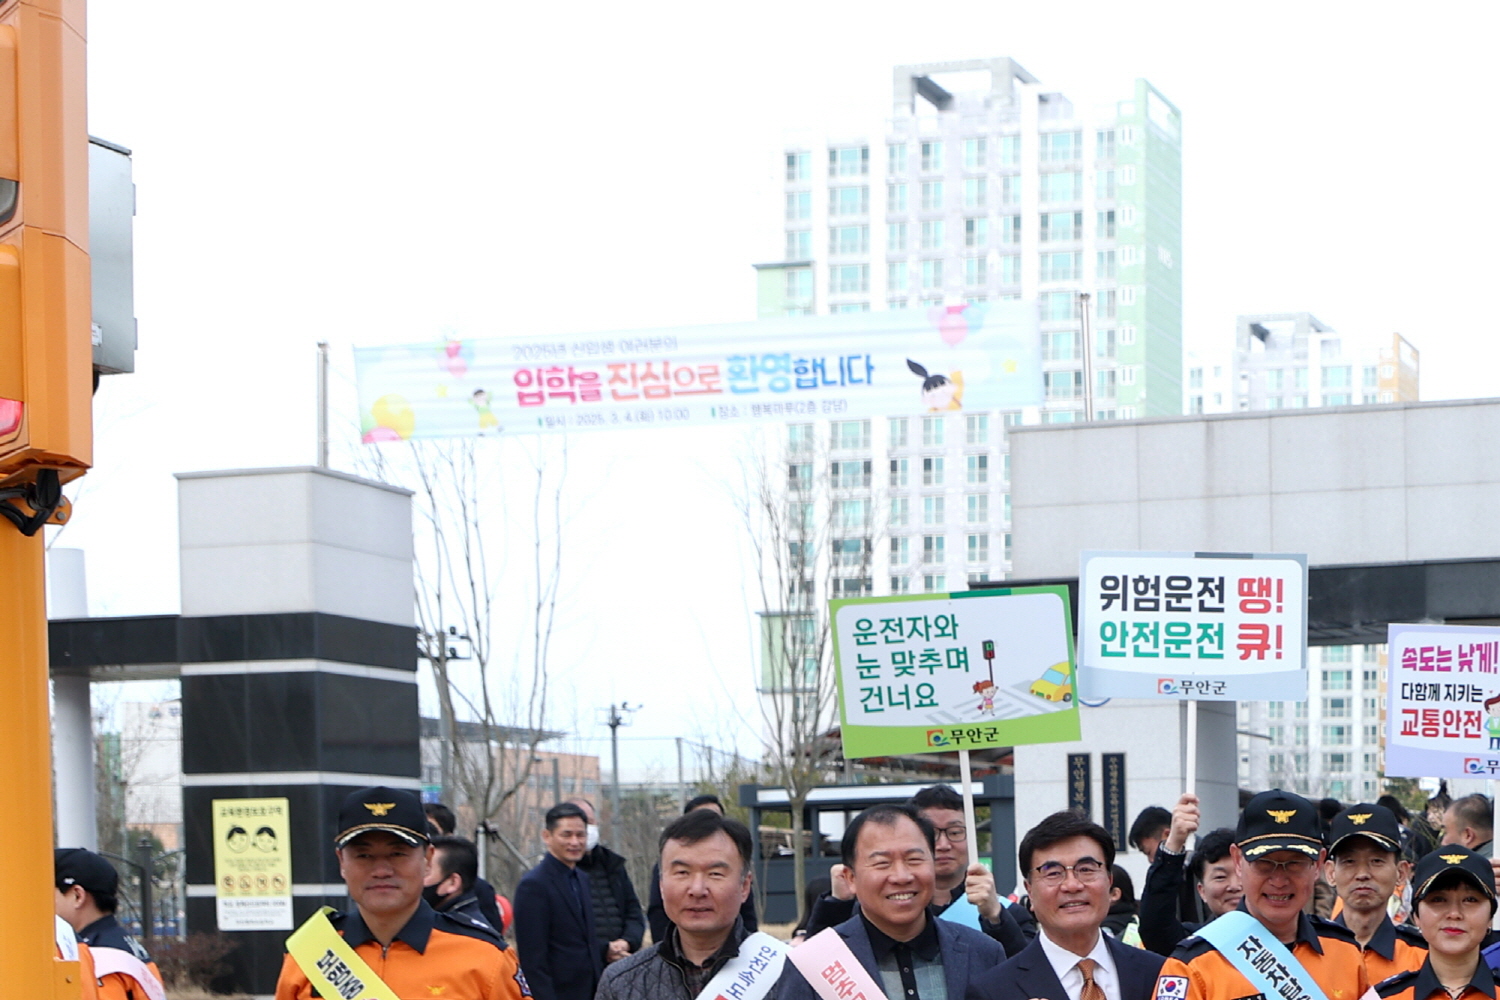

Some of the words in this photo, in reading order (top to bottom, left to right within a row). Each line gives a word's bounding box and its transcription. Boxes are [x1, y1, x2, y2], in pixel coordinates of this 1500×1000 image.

[513, 366, 603, 407] 입학을
[606, 360, 723, 402] 진심으로
[726, 352, 875, 395] 환영합니다
[1100, 575, 1225, 613] 위험운전
[1238, 577, 1283, 614] 땡!
[852, 613, 959, 646] 운전자와
[1099, 621, 1225, 659] 안전운전
[1236, 623, 1283, 661] 큐!
[856, 651, 881, 679] 눈
[891, 646, 970, 677] 맞추며
[1402, 646, 1452, 672] 속도는
[1458, 641, 1499, 674] 낮게!
[860, 682, 939, 713] 건너요
[1179, 680, 1227, 695] 무안군
[1401, 682, 1441, 702] 다함께
[1444, 683, 1483, 703] 지키는
[950, 727, 999, 744] 무안군
[1400, 708, 1482, 739] 교통안전
[316, 949, 366, 1000] 보행중
[730, 945, 778, 1000] 안전속도
